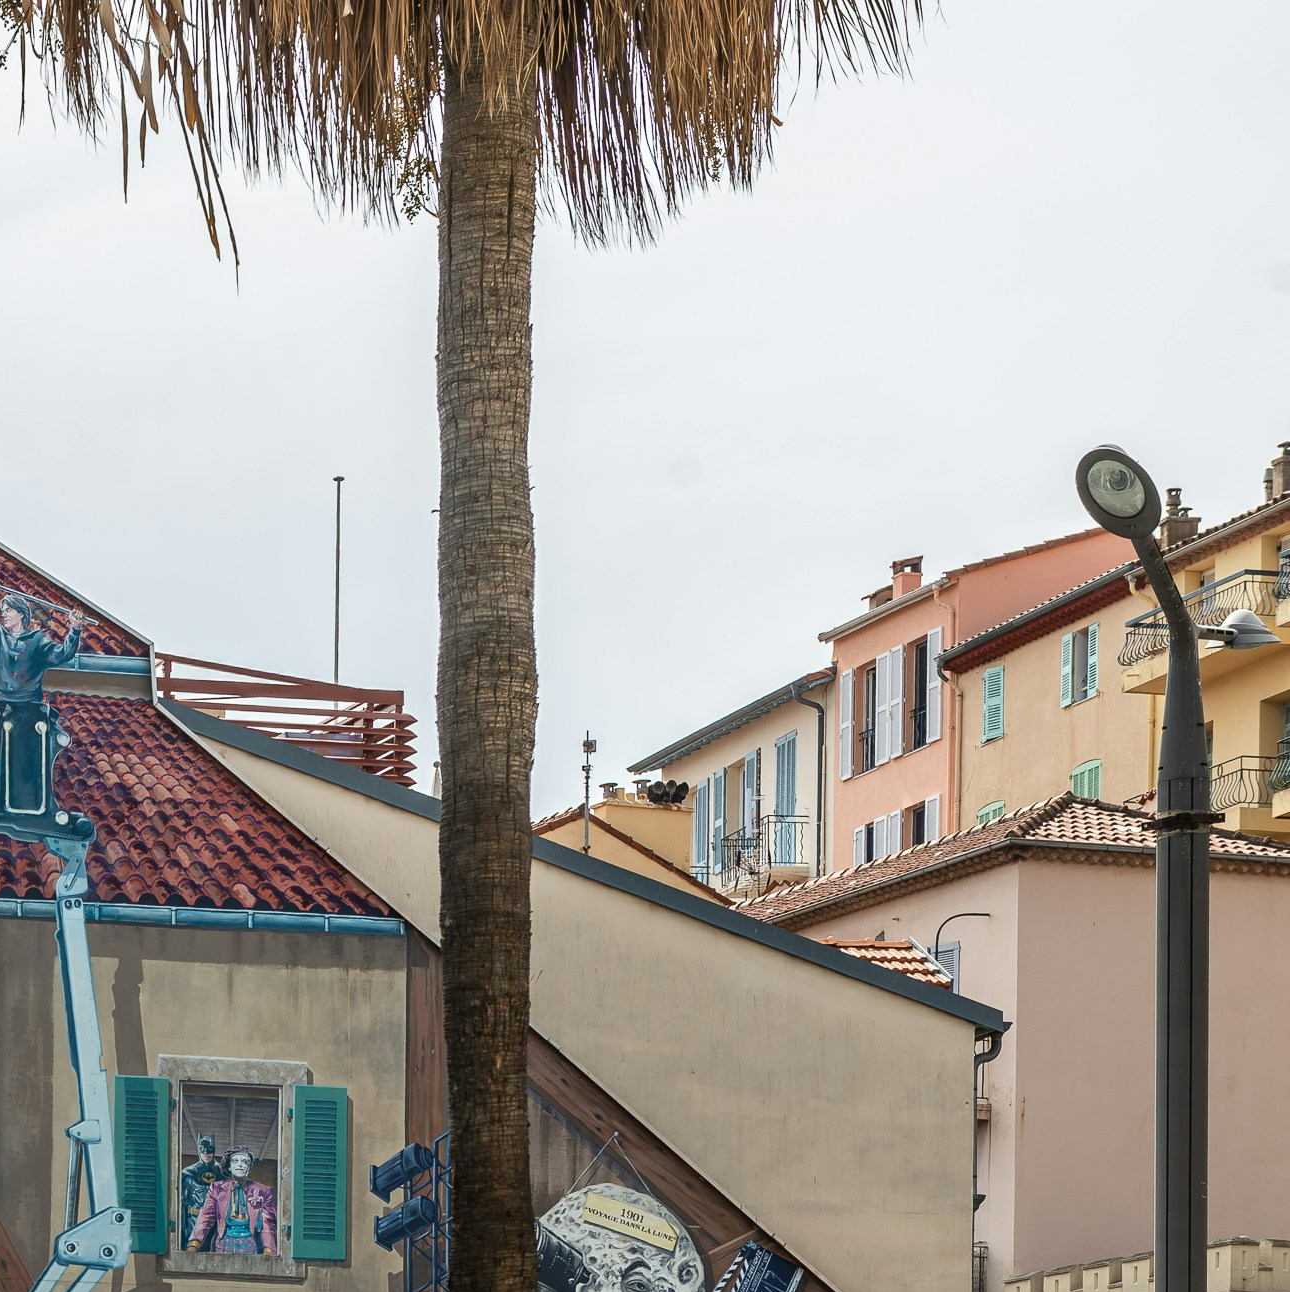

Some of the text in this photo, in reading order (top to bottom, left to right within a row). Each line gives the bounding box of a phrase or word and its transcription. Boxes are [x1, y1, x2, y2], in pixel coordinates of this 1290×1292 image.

[620, 1208, 645, 1223] 1901
[619, 1219, 640, 1230] DANS
[641, 1226, 651, 1235] LA
